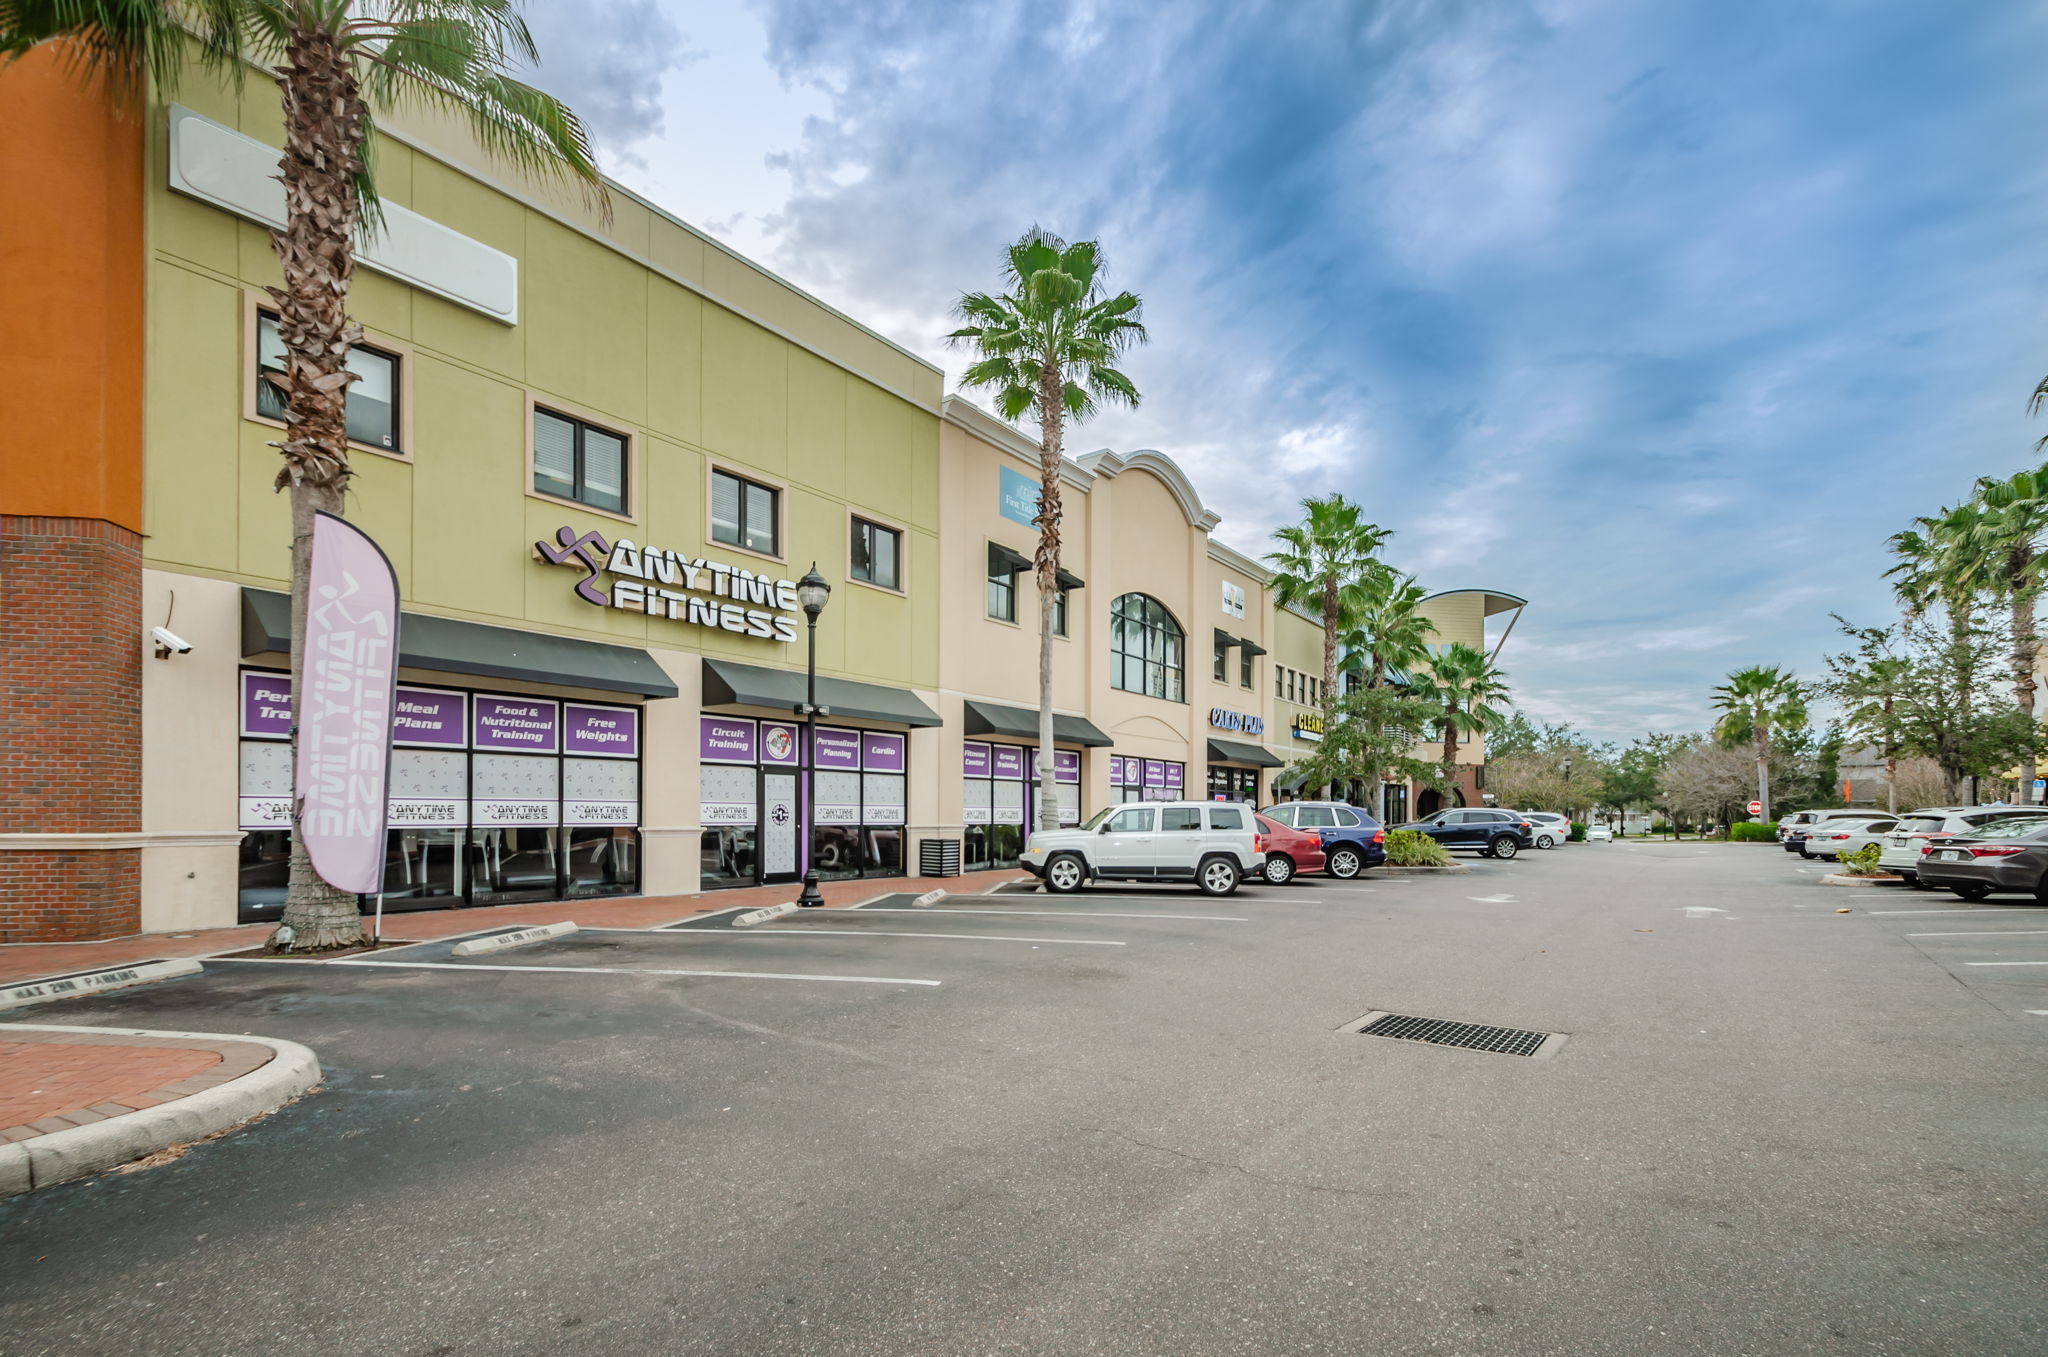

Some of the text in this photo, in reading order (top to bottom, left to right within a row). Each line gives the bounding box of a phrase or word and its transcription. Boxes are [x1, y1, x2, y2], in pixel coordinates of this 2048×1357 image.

[606, 538, 798, 612] ANYTIME
[612, 580, 798, 643] FITNESS
[397, 702, 440, 715] Meal
[494, 705, 539, 717] Food &
[394, 717, 442, 730] Plans
[480, 716, 552, 730] Nutritional
[587, 717, 617, 729] Free
[1298, 712, 1324, 733] CLEANE
[491, 729, 543, 742] Training
[575, 729, 628, 743] Weights
[712, 727, 745, 738] Circuit
[708, 738, 749, 751] Training
[816, 737, 858, 748] Personalized
[823, 748, 852, 759] Planning
[871, 746, 896, 756] Cardio
[395, 804, 456, 813] ANYTIME
[497, 805, 548, 813] ANYTIME
[584, 805, 628, 813] ANYTIME
[15, 970, 139, 1000] MAX 2HR PARKING
